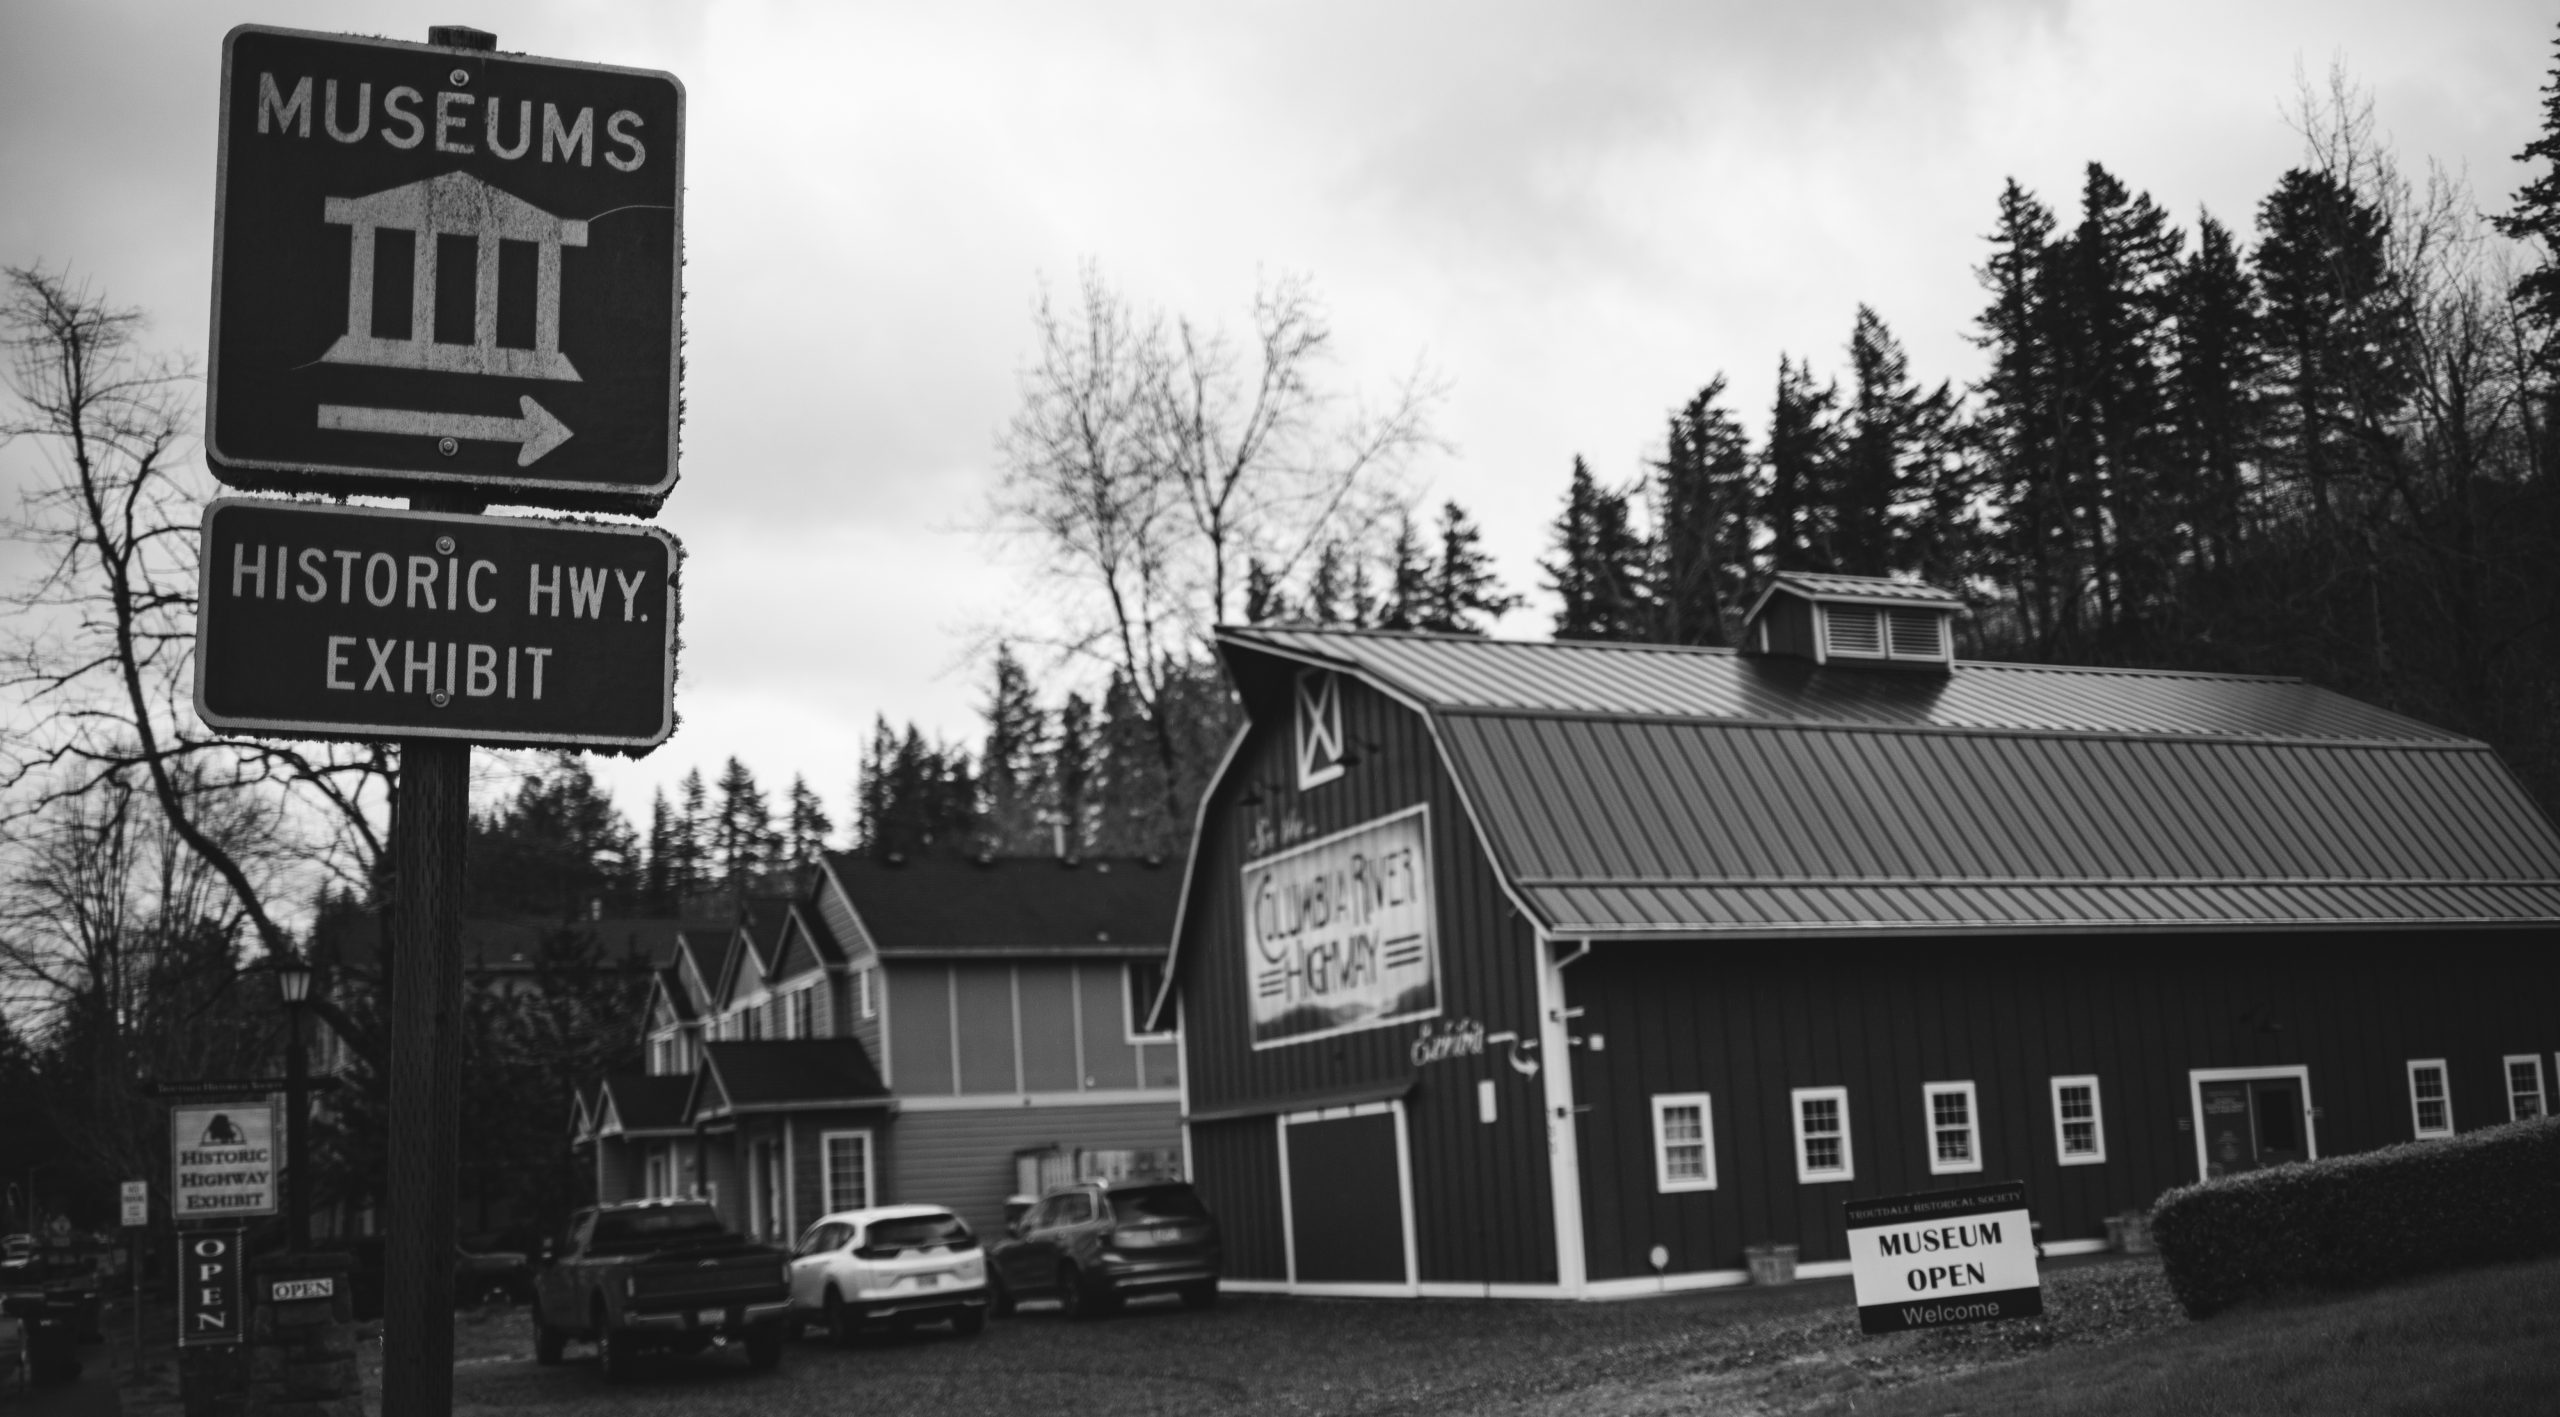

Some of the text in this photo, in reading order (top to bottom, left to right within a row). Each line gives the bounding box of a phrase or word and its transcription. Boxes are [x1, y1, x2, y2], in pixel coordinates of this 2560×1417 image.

[257, 71, 647, 173] MUSEUMS
[232, 543, 649, 622] HISTORIC HWY.
[326, 636, 553, 701] EXHIBIT
[1254, 846, 1418, 964] COLUMBIA RIVER
[1286, 928, 1380, 1003] HIGHWAY
[180, 1148, 268, 1166] HISTORIC
[180, 1171, 269, 1188] HIGHWAY
[186, 1192, 264, 1210] EXHIBIT
[1849, 1191, 2022, 1221] TROUTDALE HISTORICAL SOCIETY
[1878, 1221, 2003, 1258] MUSEUM
[194, 1238, 226, 1331] OPEN
[275, 1281, 331, 1299] OPEN
[1906, 1262, 1986, 1292] OPEN
[1901, 1301, 2001, 1326] Welcome
